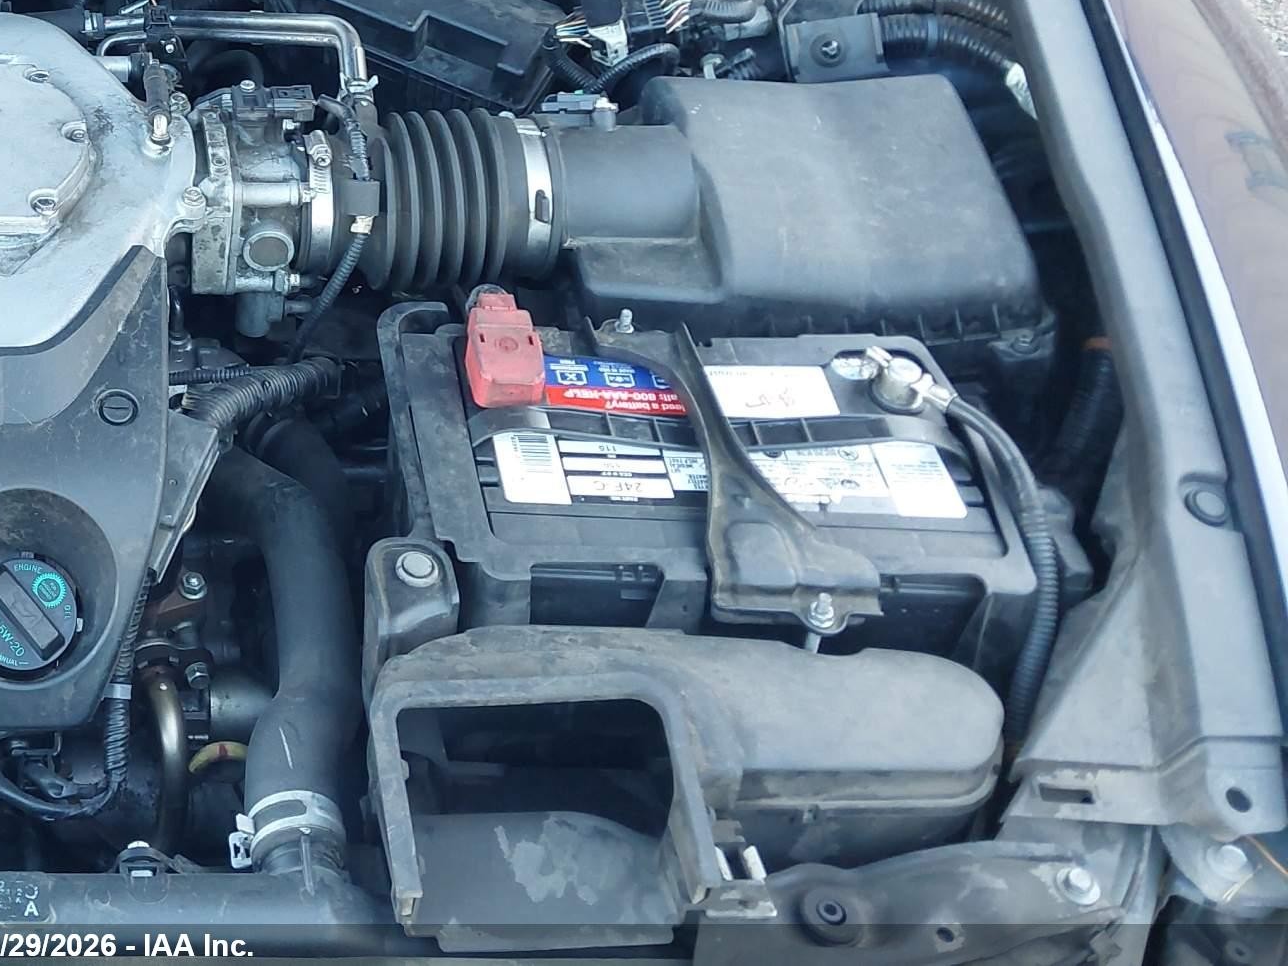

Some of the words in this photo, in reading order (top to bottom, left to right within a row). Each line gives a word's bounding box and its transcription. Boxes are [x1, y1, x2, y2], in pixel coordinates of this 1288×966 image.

[13, 563, 43, 574] ENGINE
[63, 604, 72, 619] OIL
[23, 900, 40, 917] A
